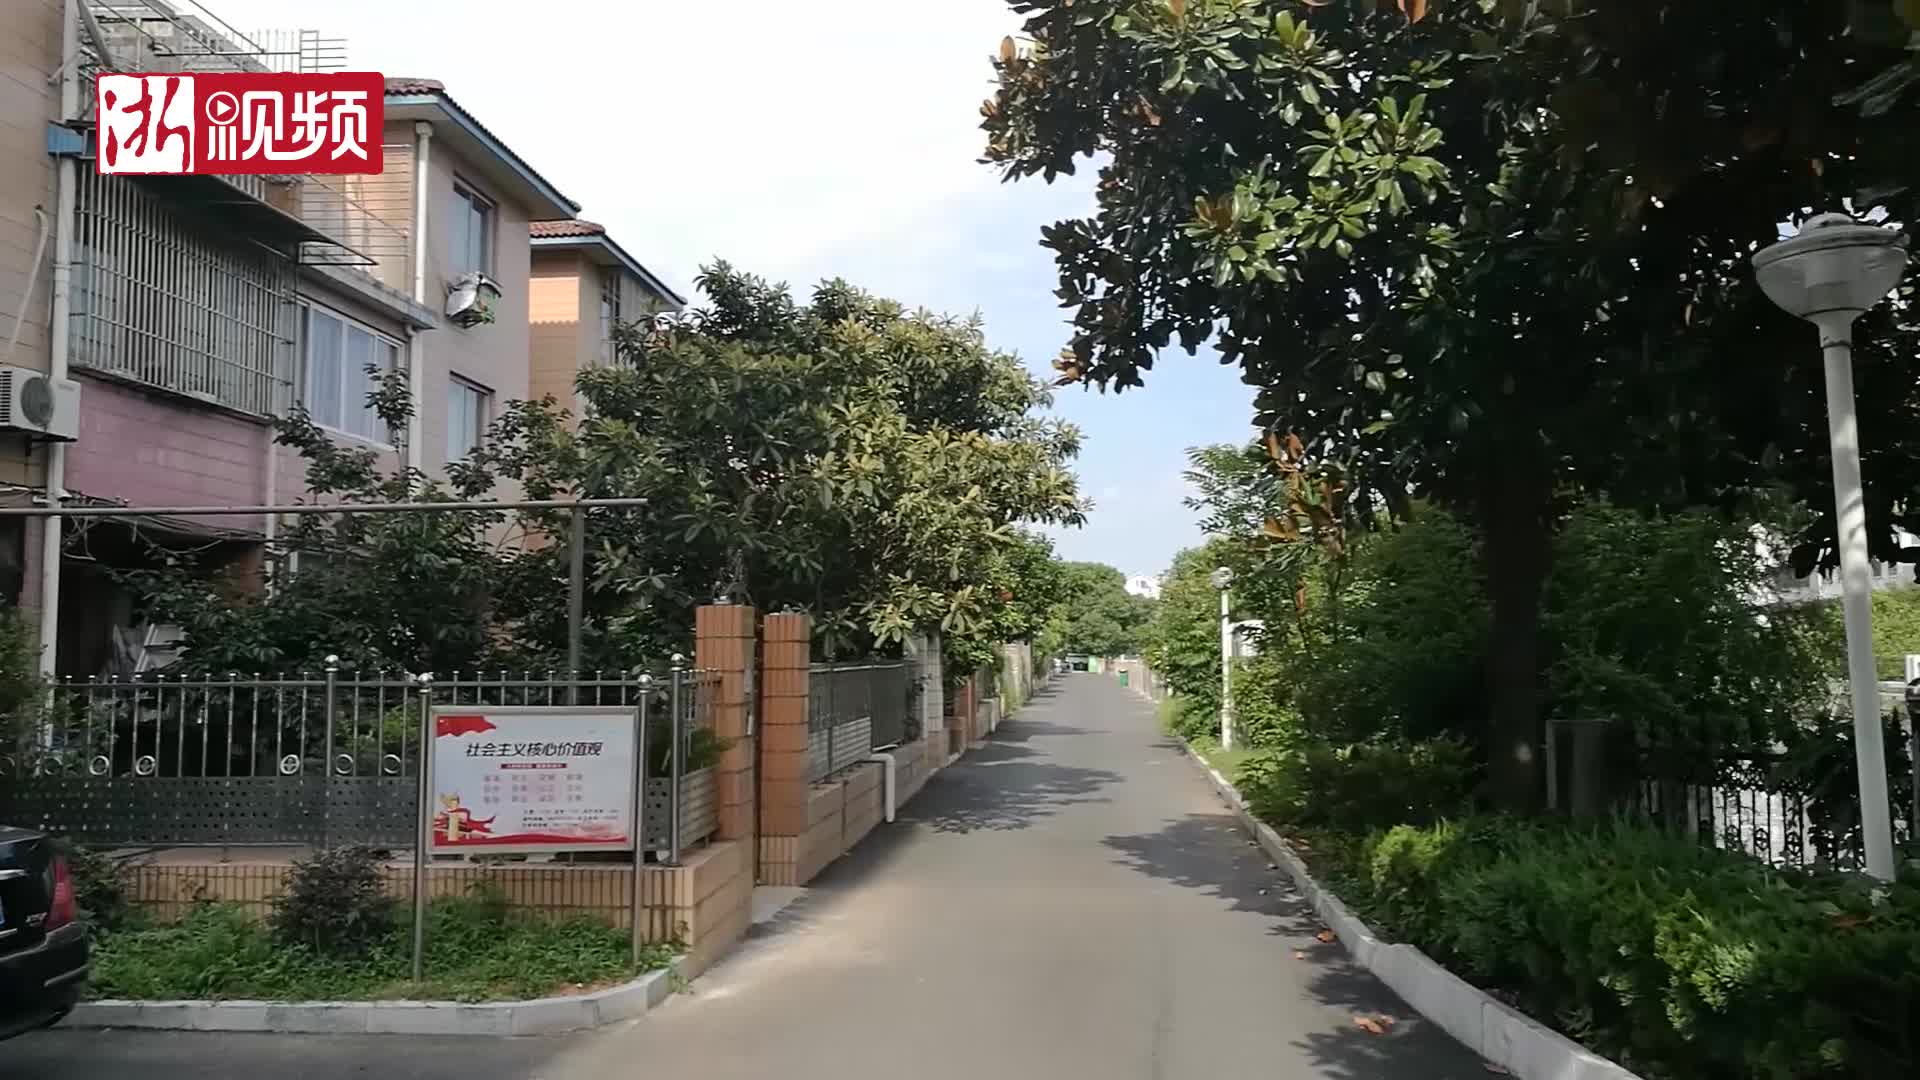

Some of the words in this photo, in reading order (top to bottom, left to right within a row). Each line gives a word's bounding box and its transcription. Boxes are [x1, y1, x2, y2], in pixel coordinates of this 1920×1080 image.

[466, 742, 603, 757] 社会主义核心价值观
